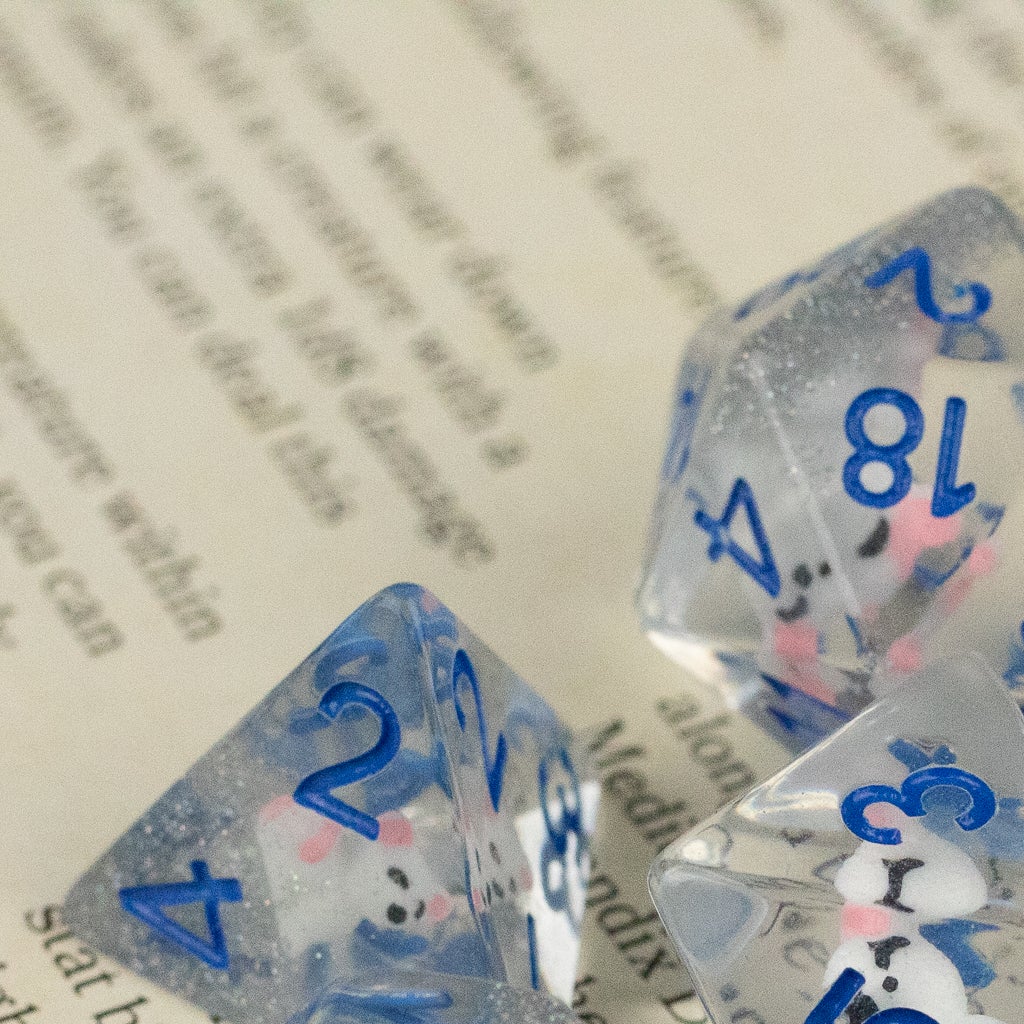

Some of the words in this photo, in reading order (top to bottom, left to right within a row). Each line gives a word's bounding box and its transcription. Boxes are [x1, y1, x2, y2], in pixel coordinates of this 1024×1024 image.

[293, 681, 401, 841] 2
[840, 766, 997, 845] 3
[118, 859, 243, 970] 4
